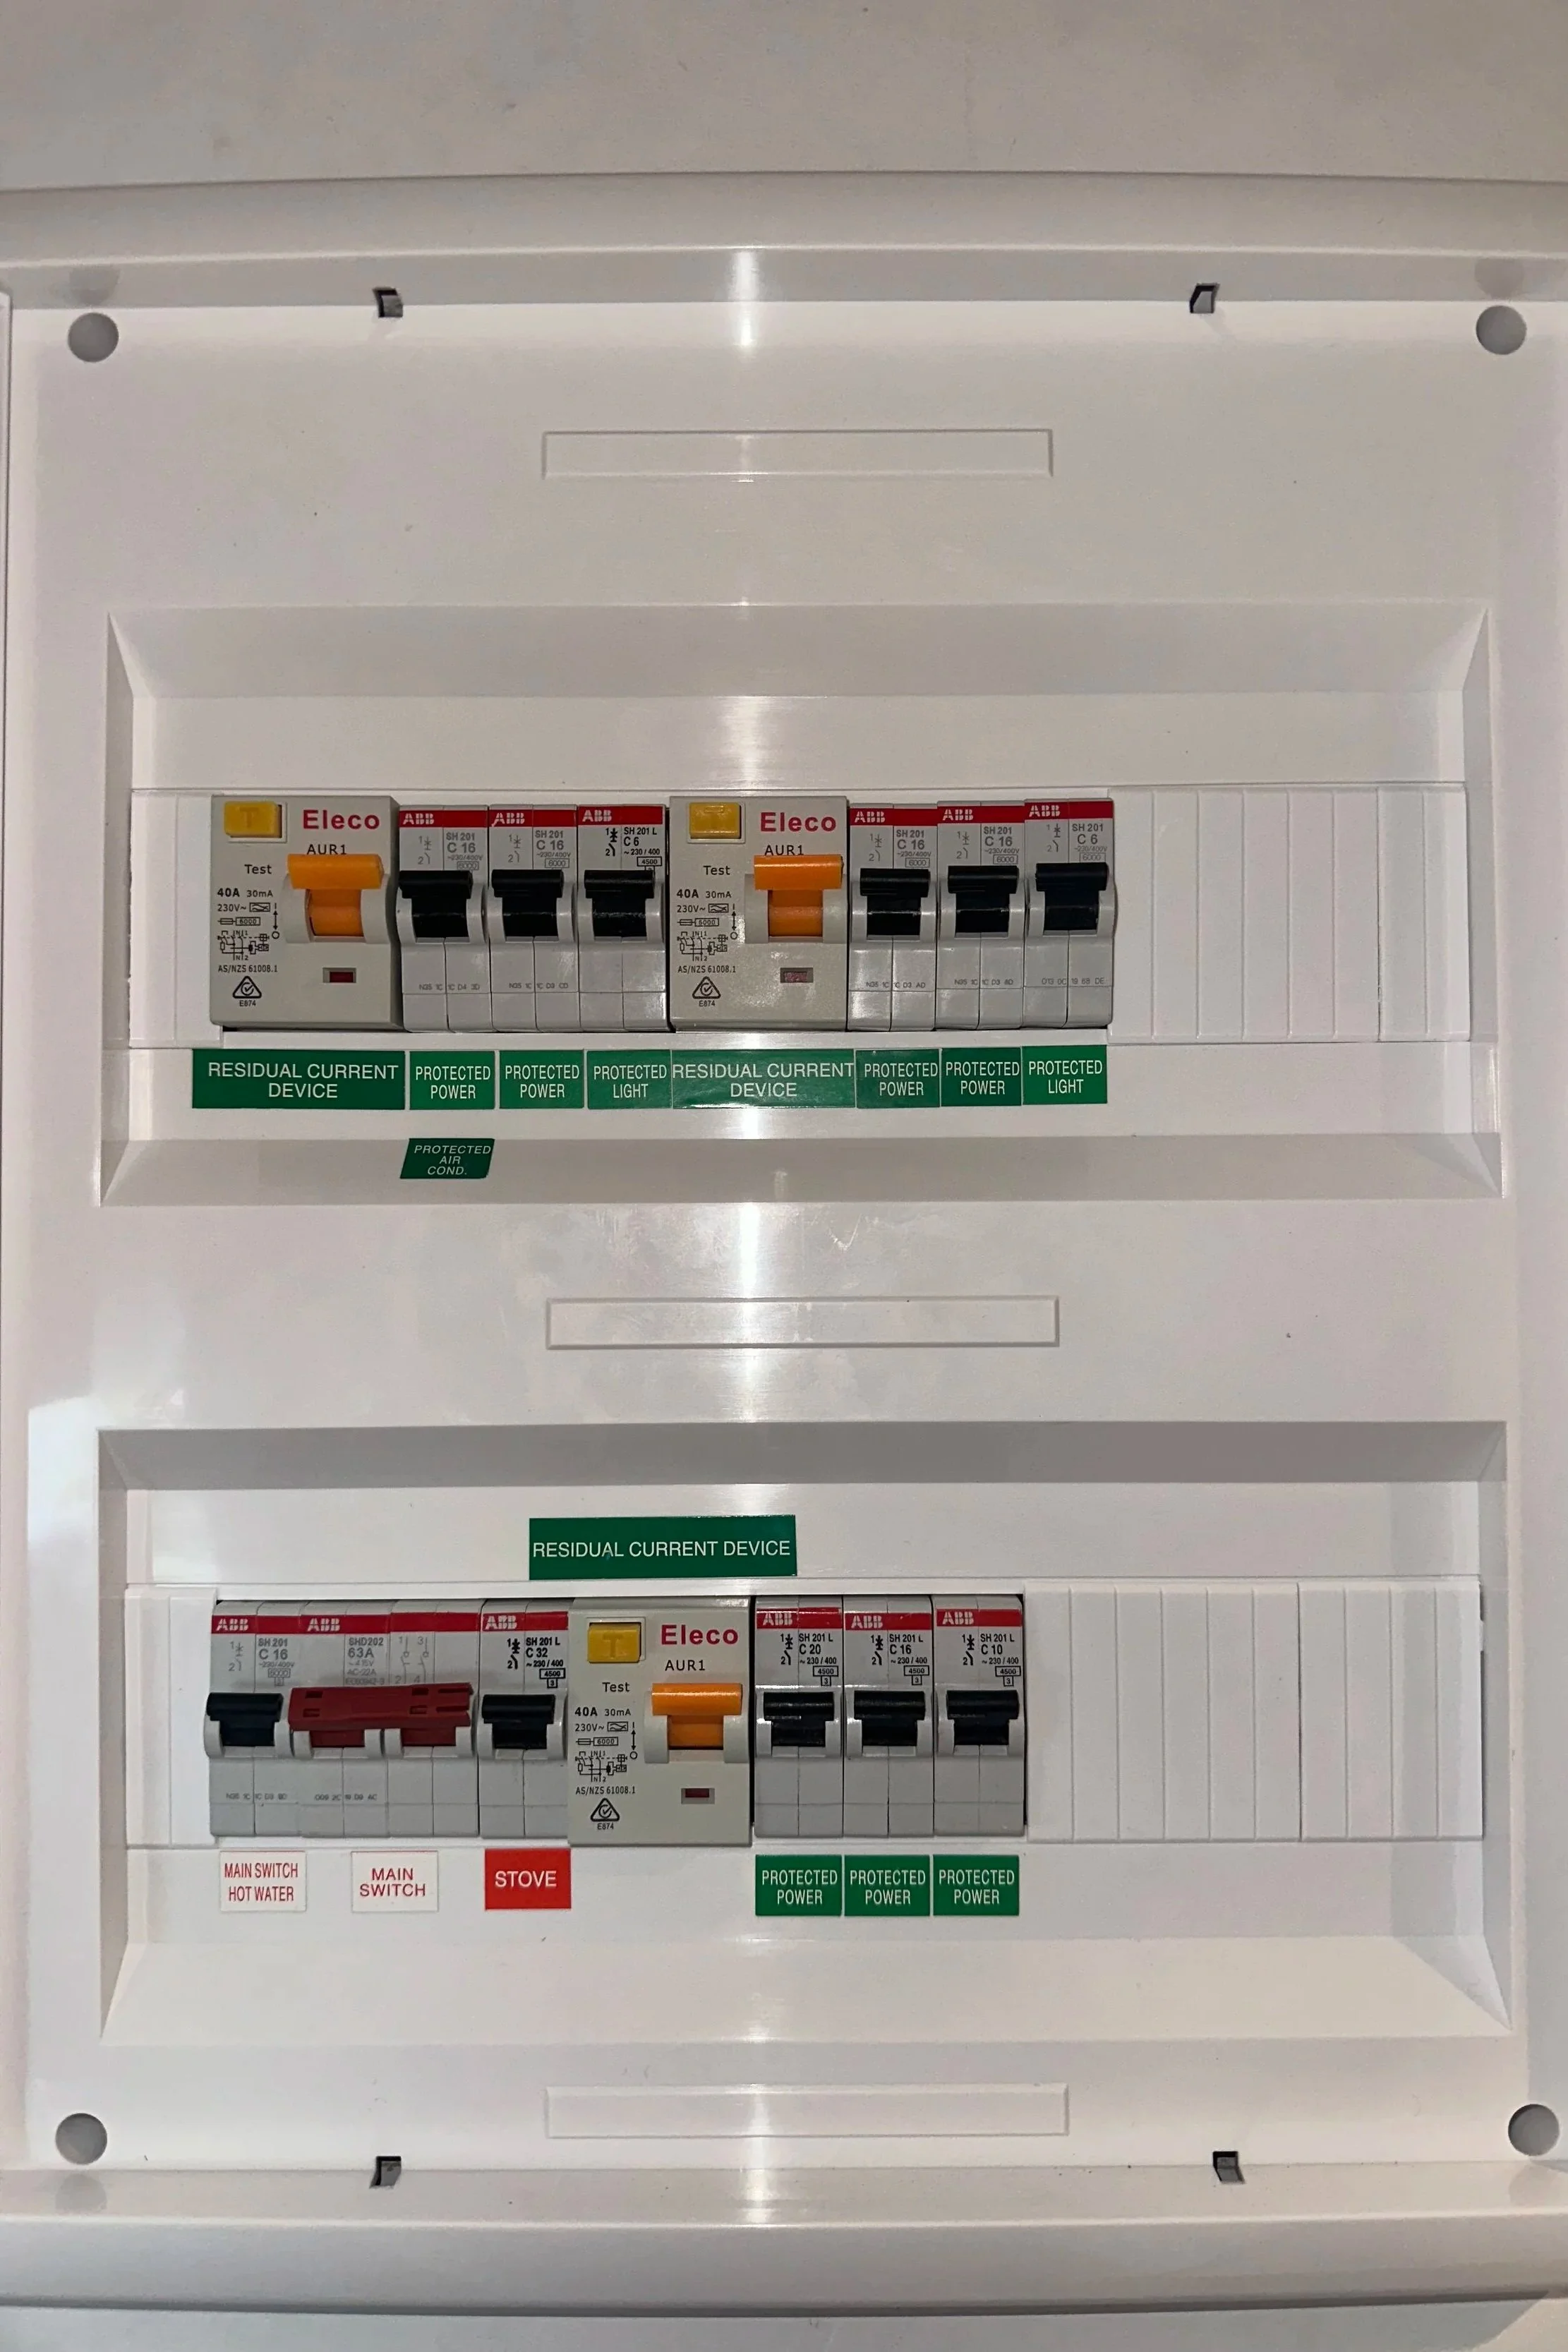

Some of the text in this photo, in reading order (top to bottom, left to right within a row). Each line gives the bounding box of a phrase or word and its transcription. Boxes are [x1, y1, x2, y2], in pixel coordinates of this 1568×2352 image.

[582, 810, 612, 821] ABB
[855, 811, 885, 823] ABB
[943, 809, 973, 820] ABB
[1029, 805, 1060, 817] ABB
[303, 810, 380, 829] Eleco
[403, 813, 435, 825] ABB
[495, 813, 525, 824] ABB
[761, 812, 836, 832] Eleco
[446, 832, 458, 840] SH
[896, 830, 924, 838] SH 201
[984, 826, 996, 836] SH
[536, 840, 564, 850] C 16
[624, 837, 639, 846] C 6
[898, 840, 924, 850] C 16
[984, 836, 1012, 846] C 16
[1078, 834, 1097, 844] C 6
[307, 845, 346, 855] AUR1
[447, 843, 476, 852] C 16
[764, 845, 804, 855] AUR1
[245, 864, 272, 874] Test
[704, 866, 730, 876] Test
[217, 888, 239, 897] 40A
[677, 889, 699, 898] 40A
[208, 1063, 399, 1079] RESIDUAL CURRENT
[416, 1066, 490, 1080] PROTECTED
[505, 1065, 579, 1079] PROTECTED
[594, 1065, 666, 1080] PROTECTED
[673, 1063, 854, 1078] RESIDUAL CURRENT
[864, 1063, 938, 1077] PROTECTED
[946, 1061, 1020, 1076] PROTECTED
[1029, 1060, 1102, 1075] PROTECTED
[269, 1083, 337, 1098] DEVICE
[430, 1085, 476, 1099] POWER
[520, 1084, 565, 1098] POWER
[613, 1084, 648, 1098] LIGHT
[730, 1083, 797, 1097] DEVICE
[880, 1082, 924, 1095] POWER
[960, 1080, 1005, 1094] POWER
[1049, 1080, 1084, 1093] LIGHT
[414, 1145, 491, 1154] PROTECTED
[428, 1166, 467, 1175] COND.
[533, 1540, 790, 1557] RESIDUAL CURRENT DEVICE
[486, 1616, 517, 1629] ABB
[763, 1612, 792, 1625] ABB
[851, 1615, 883, 1629] ABB
[943, 1612, 974, 1624] ABB
[217, 1619, 248, 1631] ABB
[308, 1618, 340, 1631] ABB
[661, 1624, 738, 1645] Eleco
[903, 1634, 915, 1643] 201
[981, 1634, 1015, 1642] SH 201 L
[259, 1648, 288, 1659] C 16
[348, 1648, 374, 1658] 63A
[526, 1648, 548, 1657] C 32
[800, 1644, 821, 1654] C 20
[890, 1644, 911, 1654] C 16
[981, 1644, 1003, 1654] C 10
[665, 1660, 705, 1671] AUR1
[603, 1682, 629, 1692] Test
[575, 1707, 598, 1716] 40A
[224, 1863, 298, 1878] MAIN SWITCH
[372, 1868, 414, 1880] MAIN
[495, 1871, 556, 1887] STOVE
[762, 1870, 837, 1885] PROTECTED
[850, 1870, 926, 1885] PROTECTED
[939, 1869, 1014, 1885] PROTECTED
[229, 1886, 294, 1901] HOT WATER
[360, 1884, 426, 1897] SWITCH
[777, 1890, 822, 1905] POWER
[865, 1890, 910, 1905] POWER
[954, 1890, 999, 1904] POWER
